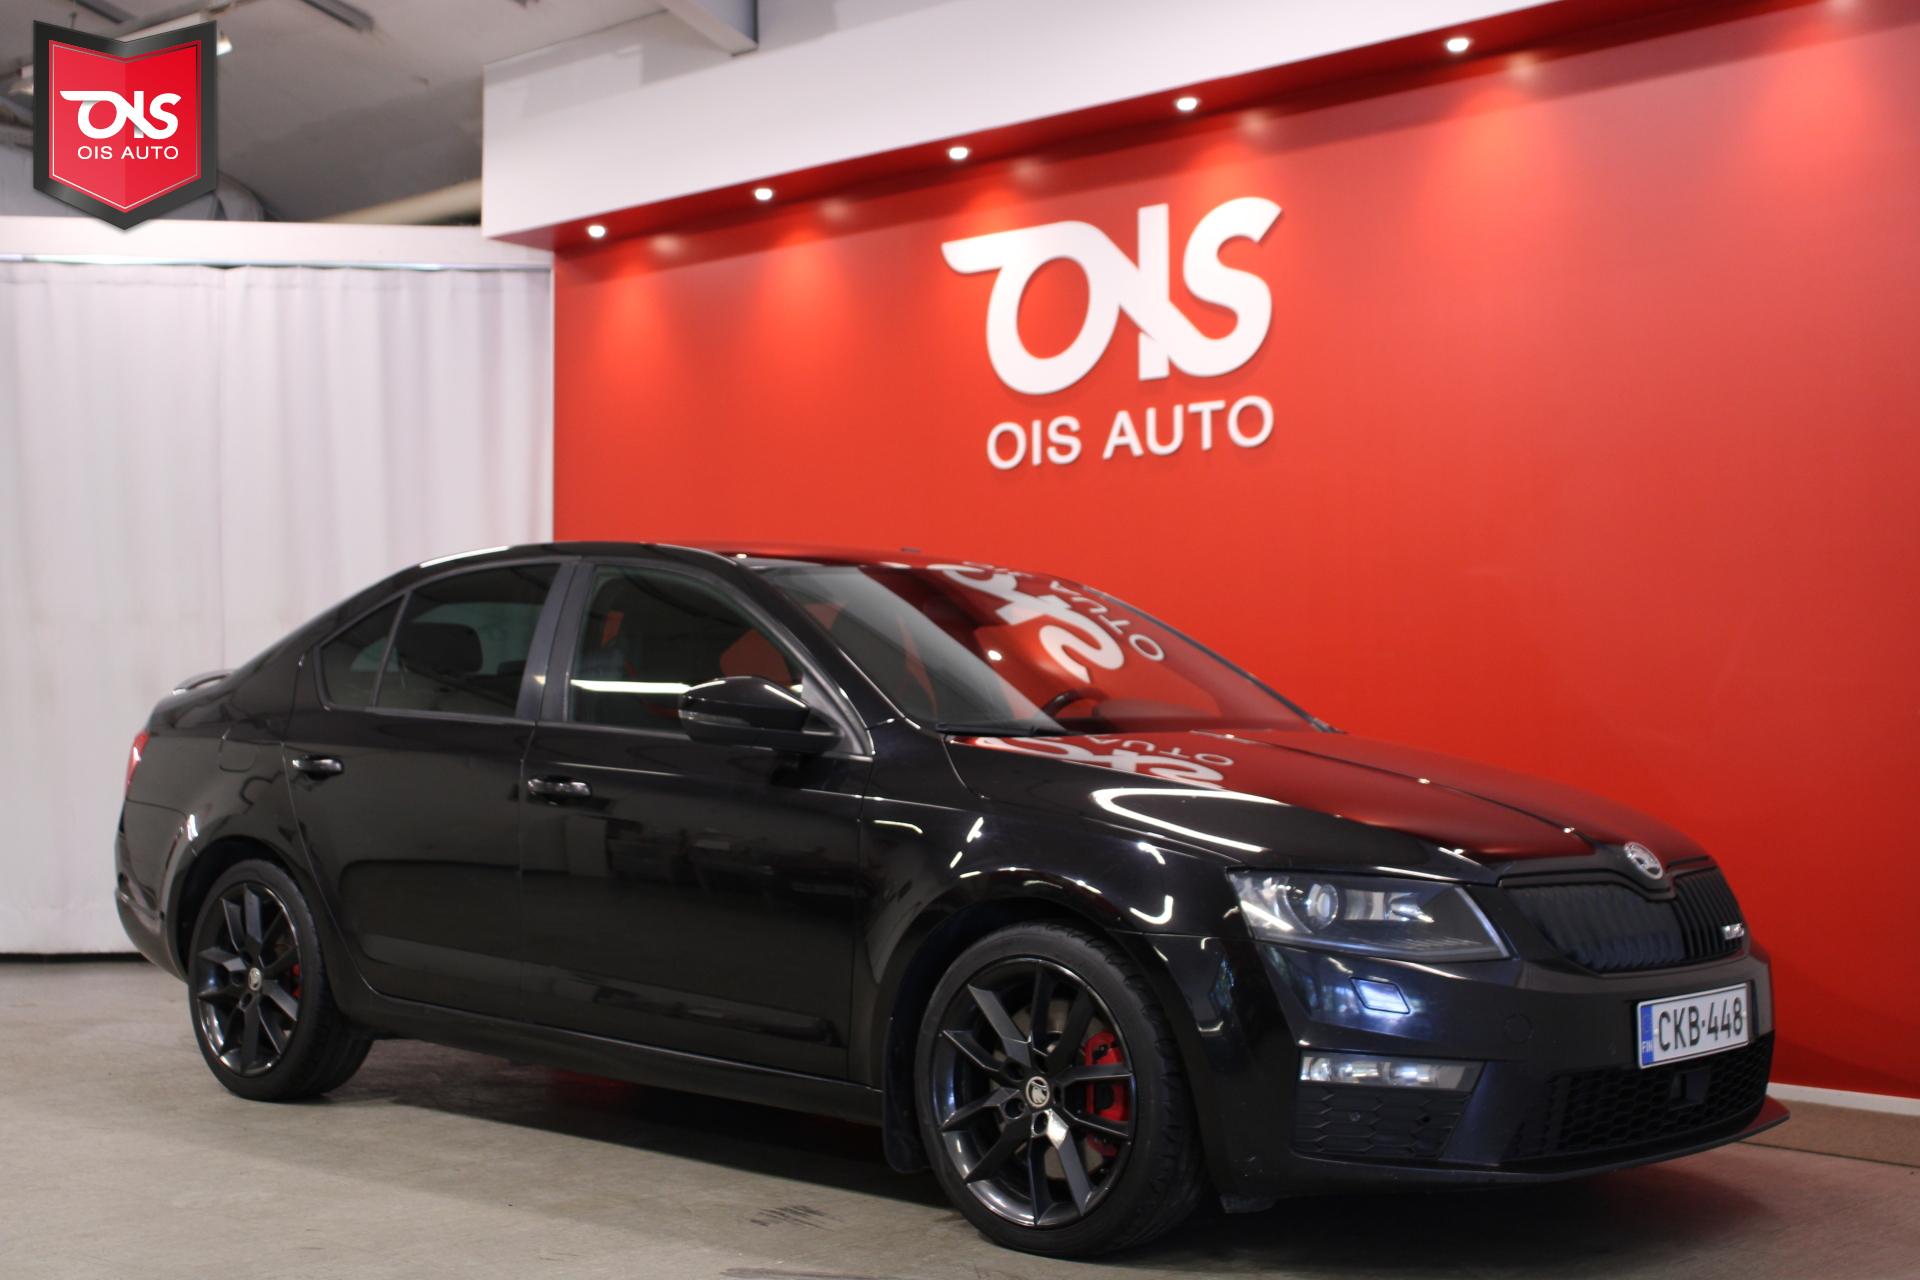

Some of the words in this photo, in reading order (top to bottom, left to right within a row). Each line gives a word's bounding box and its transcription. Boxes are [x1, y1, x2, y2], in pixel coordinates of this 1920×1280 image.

[941, 196, 1282, 395] OIS
[986, 415, 1082, 470] OIS
[1102, 395, 1274, 460] AUTO
[1659, 998, 1743, 1051] CKB-448
